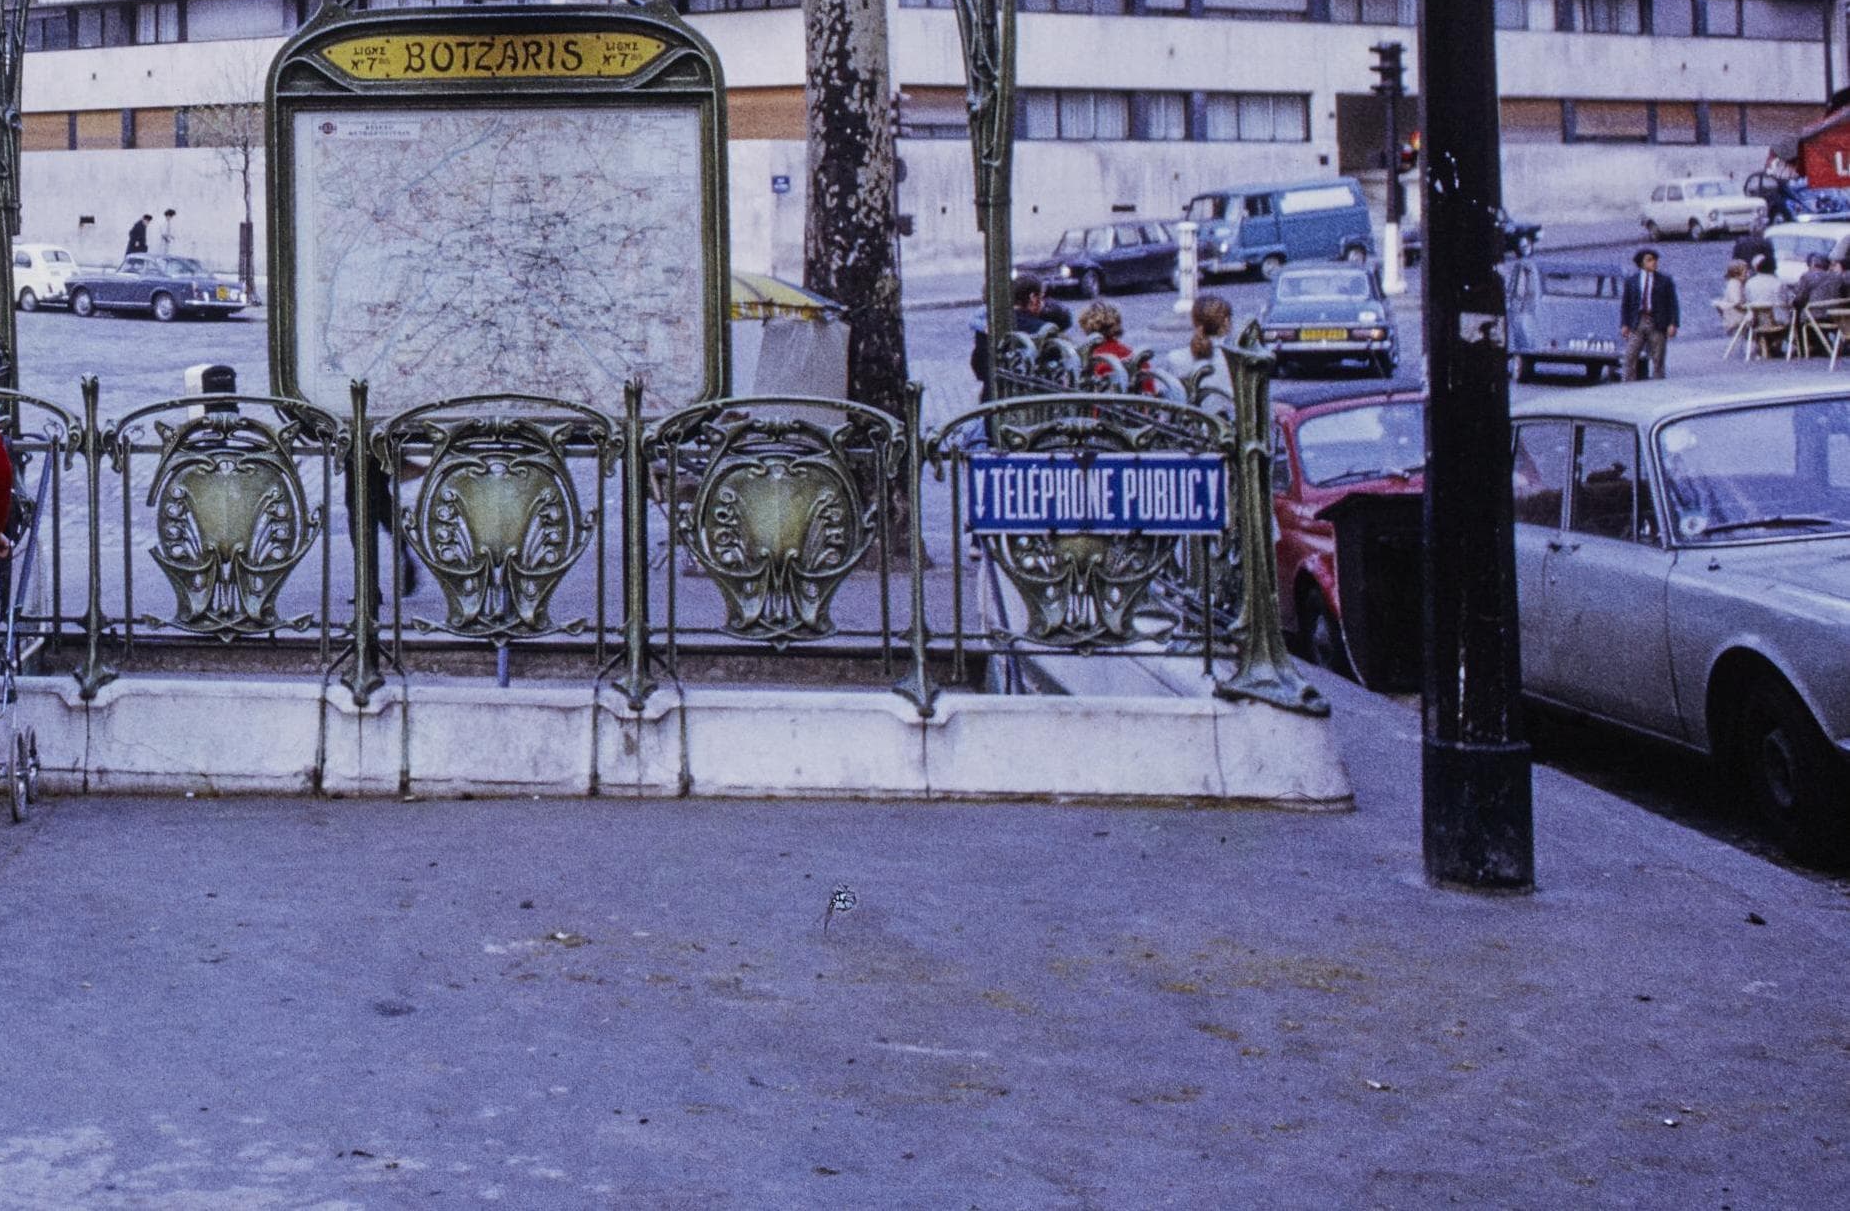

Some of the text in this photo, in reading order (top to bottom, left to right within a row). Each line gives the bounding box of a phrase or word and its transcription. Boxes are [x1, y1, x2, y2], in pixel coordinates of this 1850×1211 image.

[353, 46, 387, 56] LIGNE
[403, 39, 583, 74] BOTZARIS
[605, 42, 639, 52] LIGNE
[1834, 150, 1850, 177] L
[990, 463, 1203, 521] TÉLÉPHONE PUBLIC
